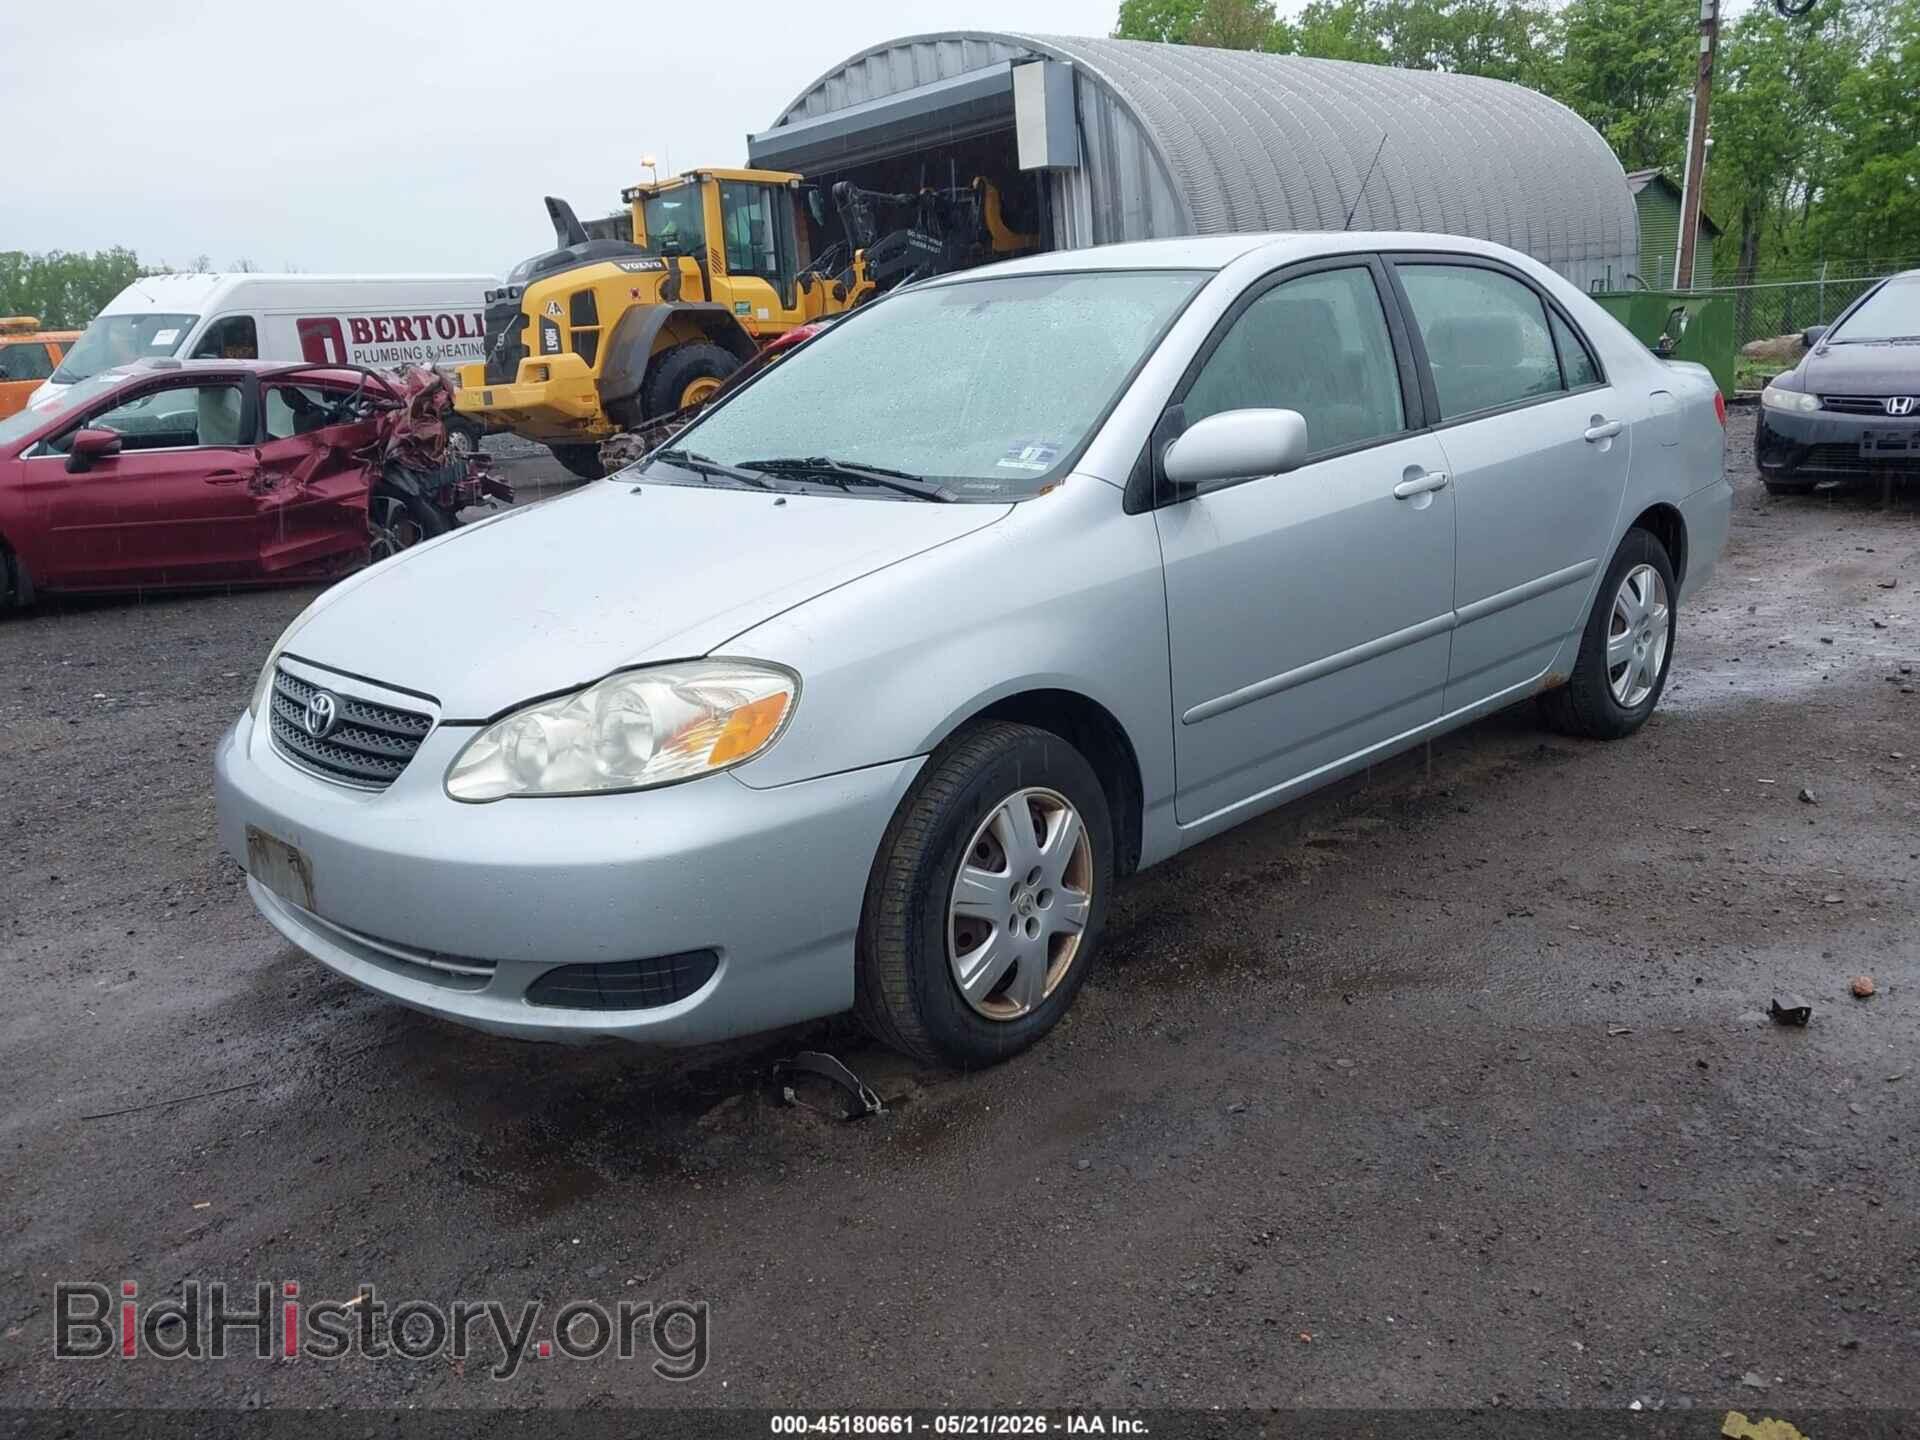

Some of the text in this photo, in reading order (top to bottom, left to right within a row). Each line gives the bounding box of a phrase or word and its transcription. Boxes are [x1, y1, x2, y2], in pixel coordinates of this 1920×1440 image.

[620, 261, 662, 270] VOLVO
[353, 346, 423, 364] PLUMBING
[426, 345, 434, 359] &
